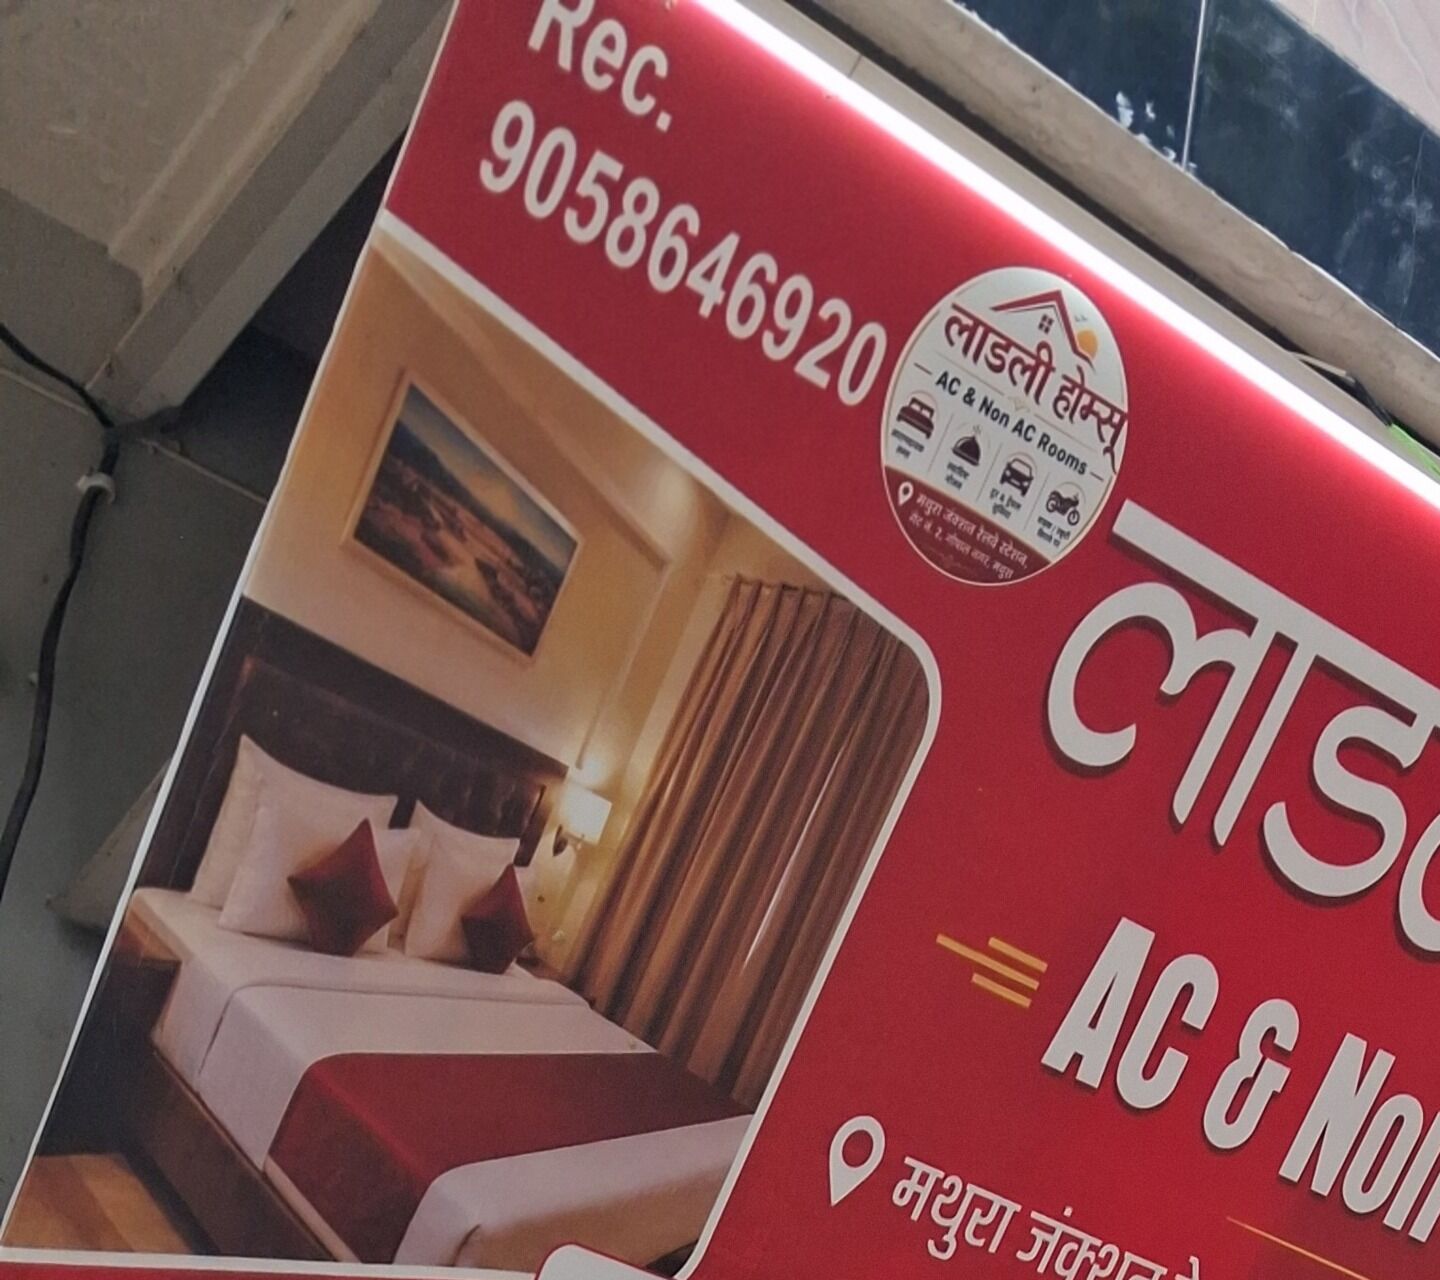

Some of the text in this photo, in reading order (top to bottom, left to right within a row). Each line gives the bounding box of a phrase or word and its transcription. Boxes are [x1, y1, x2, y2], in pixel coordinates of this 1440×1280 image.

[528, 0, 673, 132] Rec.
[479, 100, 886, 406] 9058646920
[944, 302, 1056, 404] लाडली
[936, 371, 1087, 476] AC & Non AC Rooms
[1041, 916, 1220, 1110] AC
[1203, 998, 1300, 1150] &
[892, 1156, 1021, 1260] मथुरा
